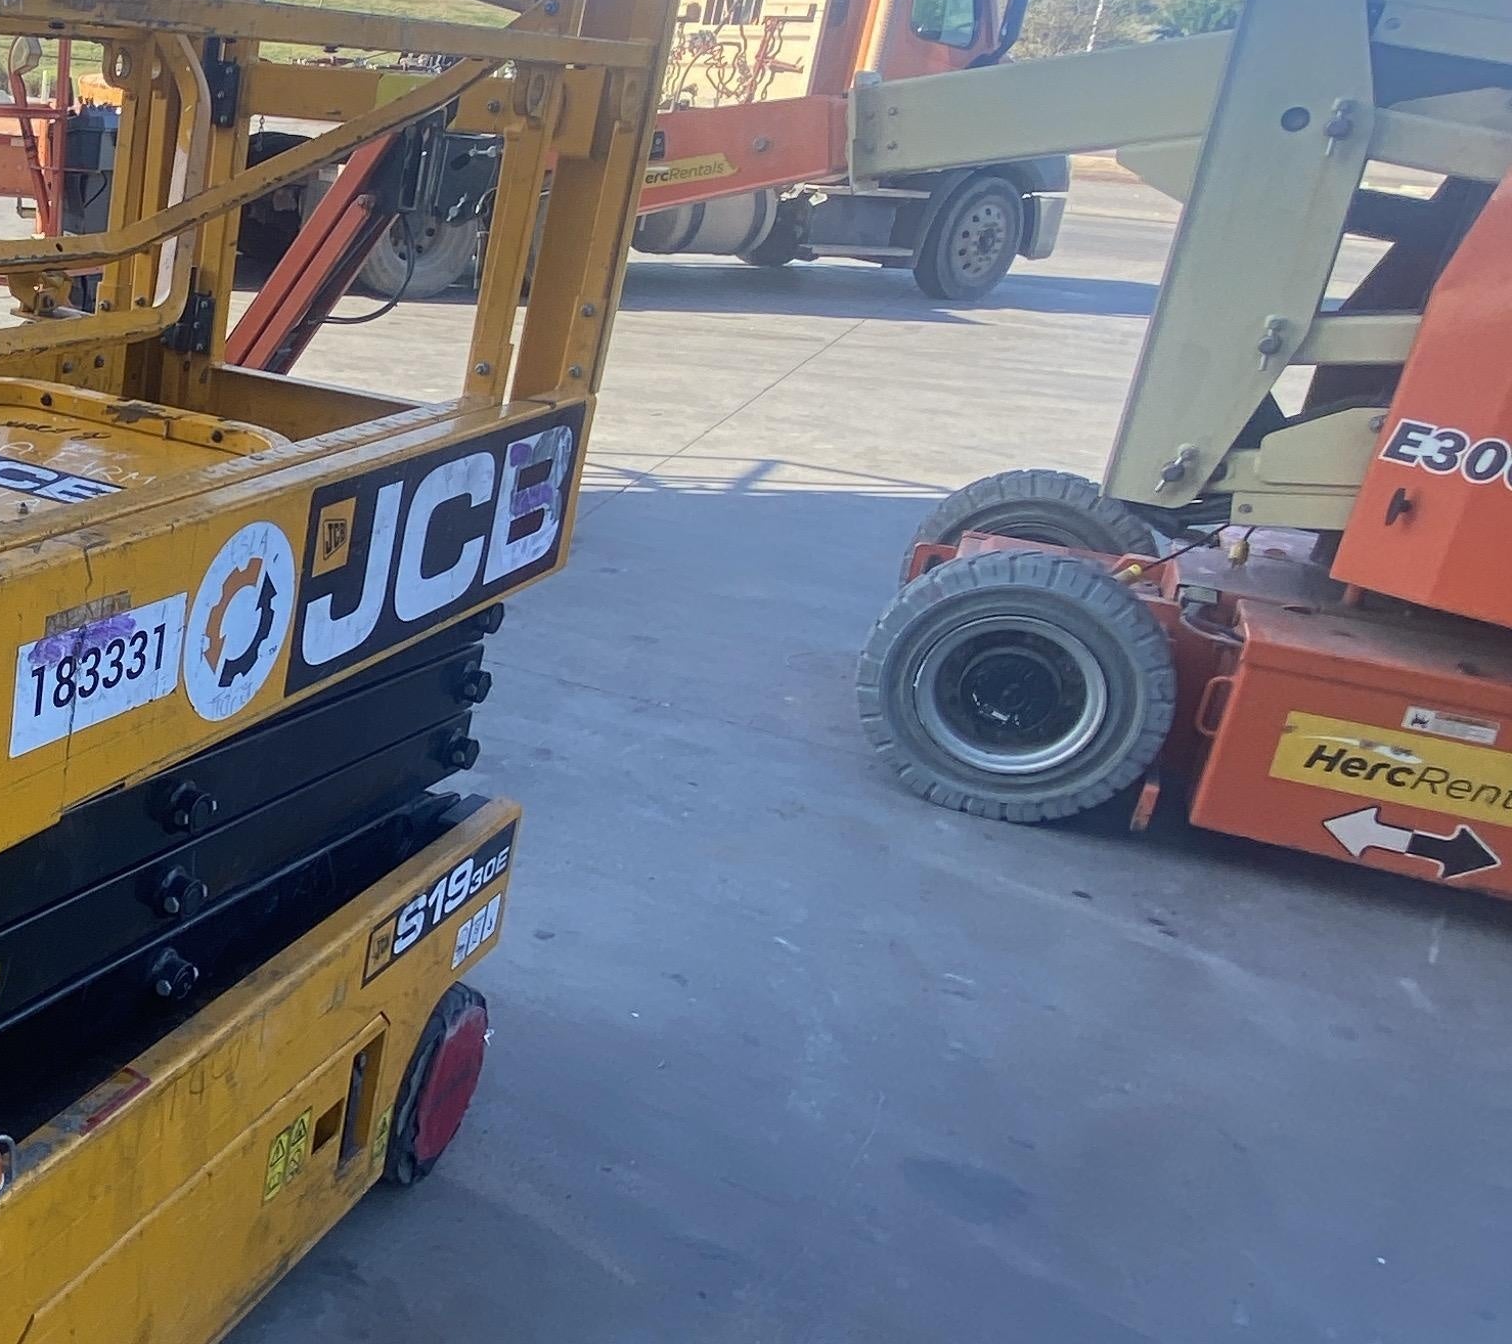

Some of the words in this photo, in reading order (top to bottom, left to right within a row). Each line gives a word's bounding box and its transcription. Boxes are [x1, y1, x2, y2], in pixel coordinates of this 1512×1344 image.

[645, 159, 725, 185] ercRentals
[1377, 417, 1512, 492] E30
[302, 425, 574, 666] JCB
[31, 622, 166, 718] 183331
